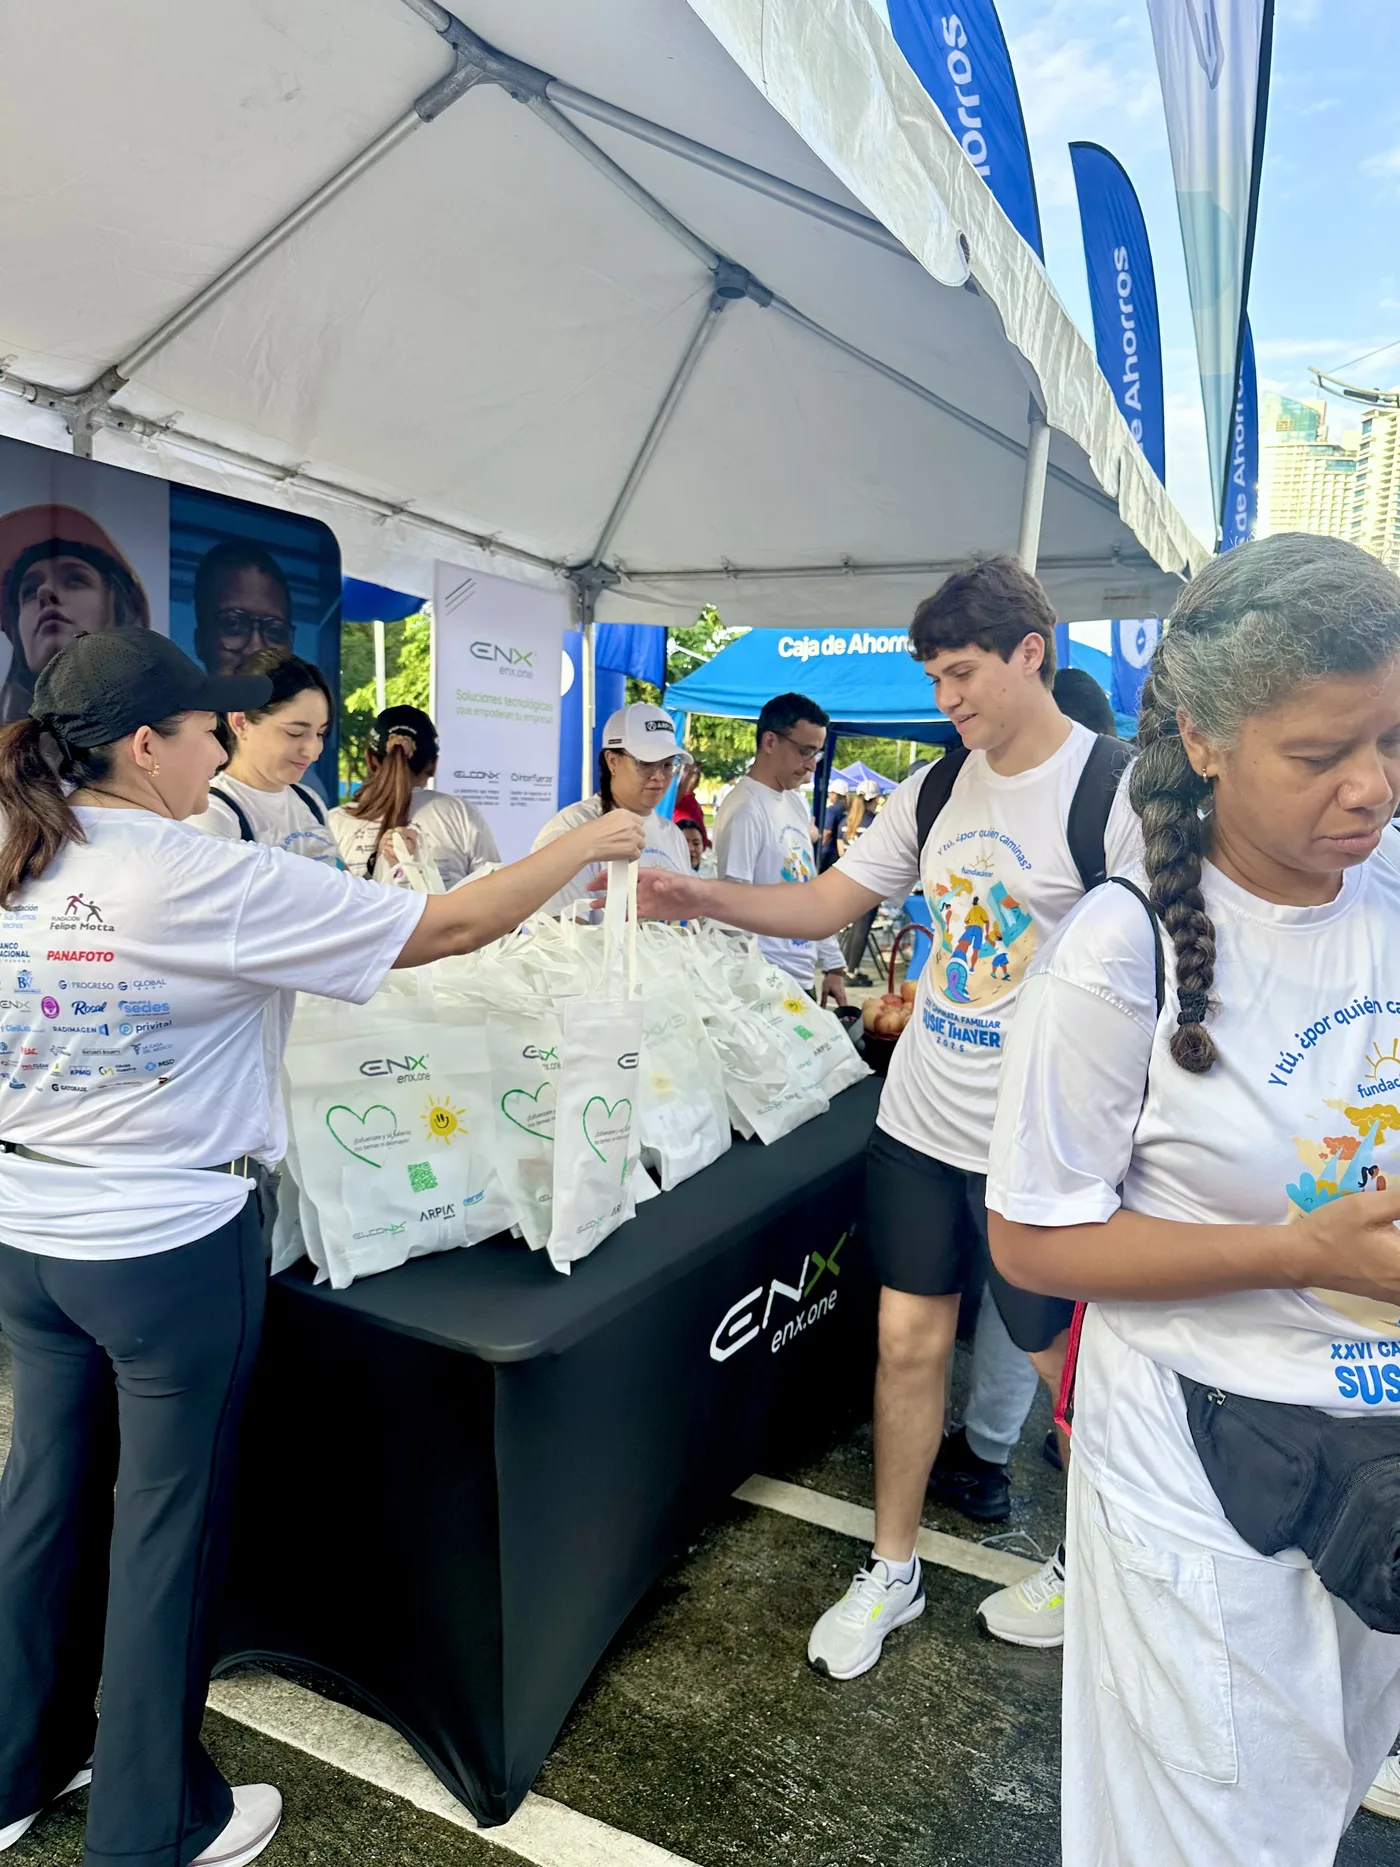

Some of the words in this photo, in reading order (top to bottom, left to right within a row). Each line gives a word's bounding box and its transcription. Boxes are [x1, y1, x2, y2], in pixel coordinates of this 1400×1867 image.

[941, 13, 991, 177] orros
[1113, 245, 1142, 412] Ahorros
[1233, 361, 1246, 487] Ahorr
[1235, 493, 1248, 532] de
[470, 641, 533, 668] ENX
[780, 636, 820, 663] Caja
[821, 634, 847, 656] de
[500, 665, 534, 680] enx.one
[456, 689, 502, 706] Soluciones
[956, 830, 978, 842] ¿por
[978, 828, 1000, 839] quién
[999, 835, 1032, 871] caminas?
[50, 922, 77, 931] Felipe
[79, 923, 116, 932] Motta
[0, 942, 19, 950] ANCO
[0, 950, 31, 958] ACIONAL
[47, 950, 115, 963] PANAFOTO
[72, 981, 115, 990] PROGRESO
[133, 979, 167, 988] GLOBAL
[124, 1000, 170, 1013] sedes
[136, 1020, 173, 1033] privital
[961, 1016, 1001, 1029] FAMILIAR
[948, 1021, 1001, 1048] THAYER
[1275, 1051, 1305, 1075] tú,
[1294, 1015, 1332, 1049] ¿por
[1333, 995, 1383, 1026] quién
[158, 1059, 175, 1067] MSD
[359, 1054, 428, 1077] ENX
[397, 1072, 431, 1084] enx.one
[1357, 1077, 1400, 1099] fundac
[420, 1204, 455, 1222] ARPIA
[709, 1231, 848, 1363] ENX
[771, 1289, 839, 1354] enx.one
[1330, 1341, 1373, 1360] XXVI
[1334, 1363, 1400, 1405] SUS
